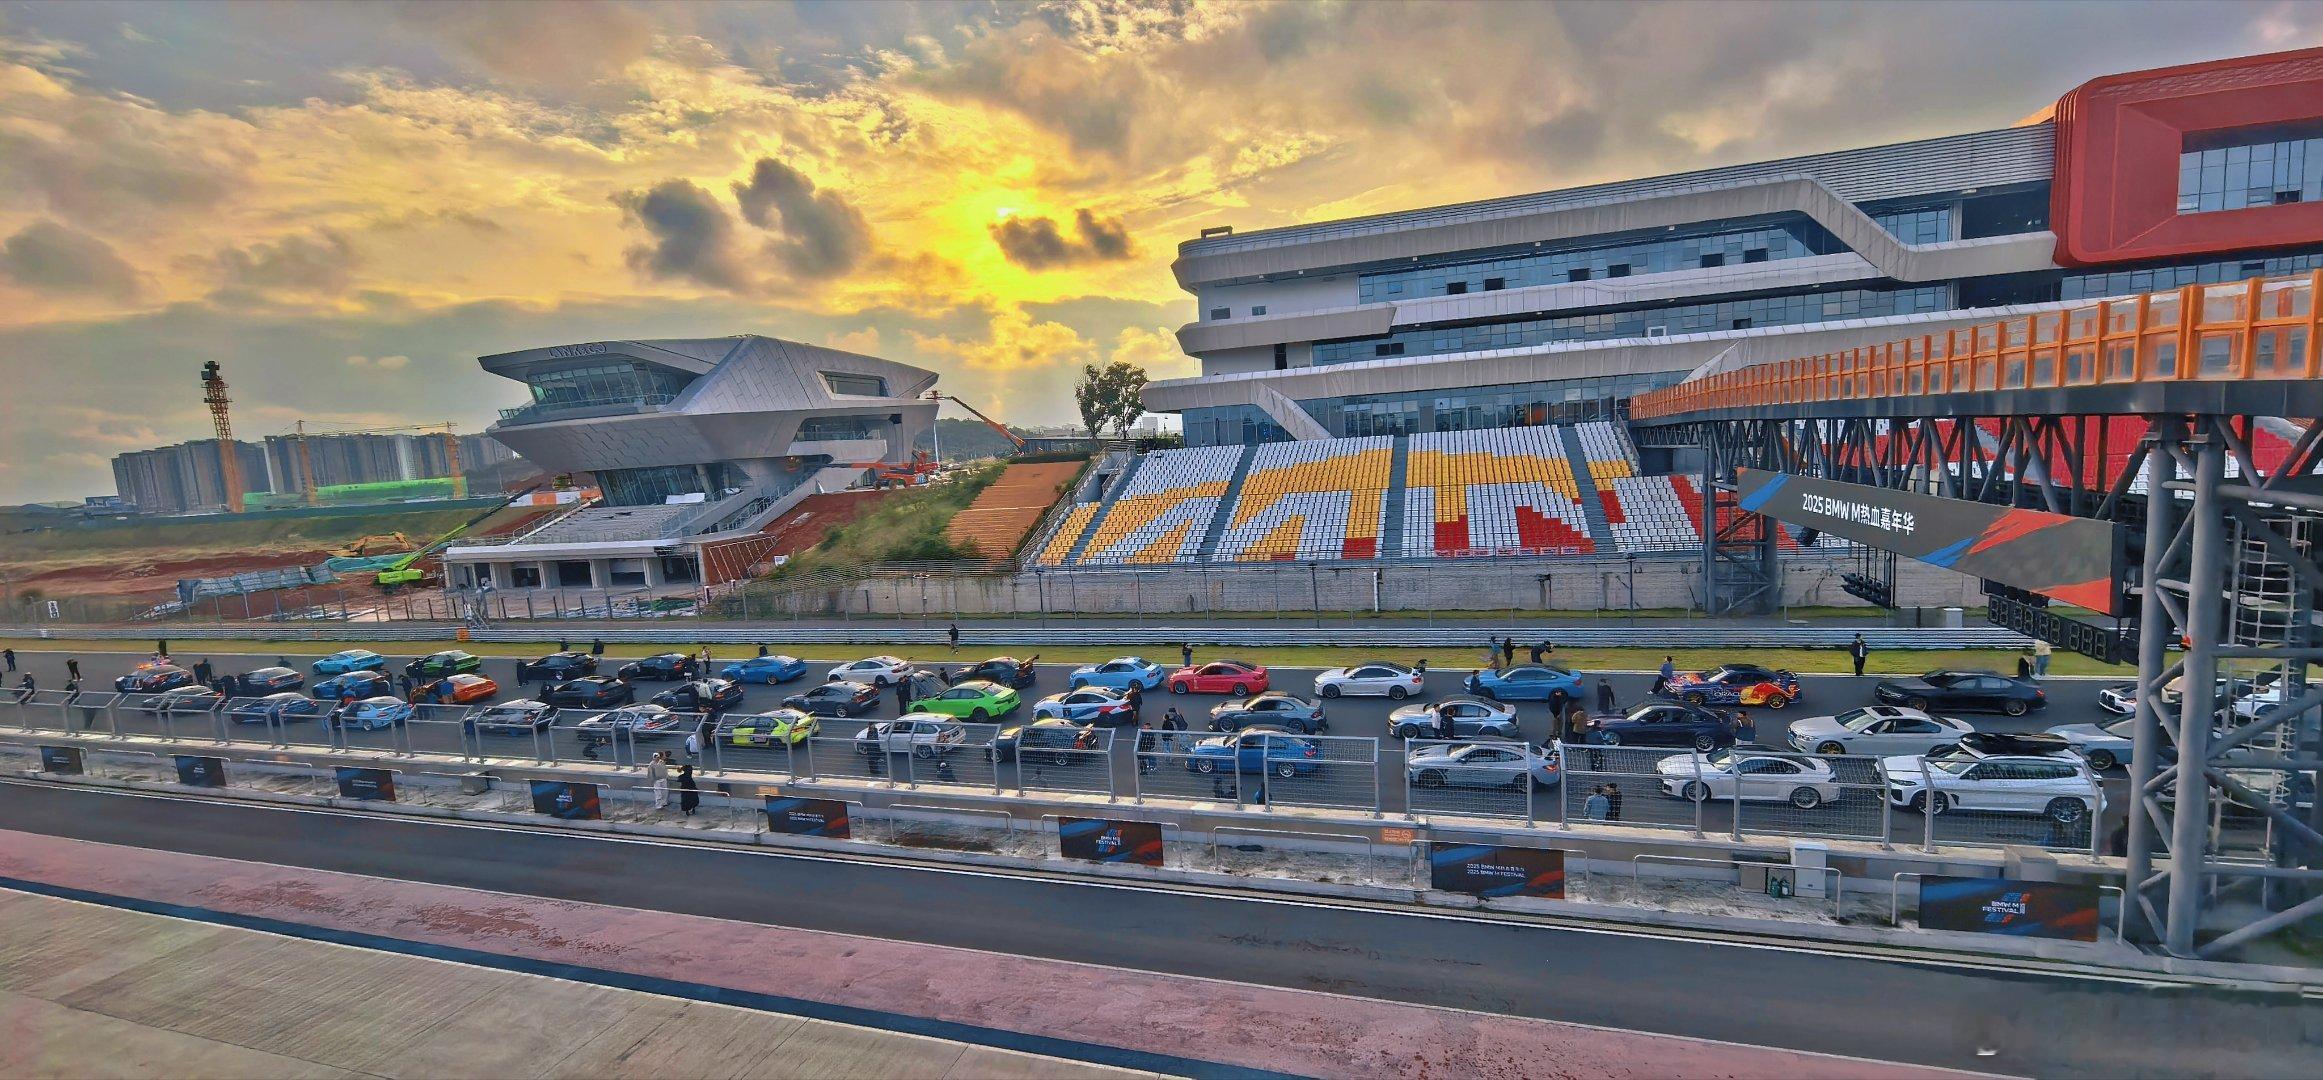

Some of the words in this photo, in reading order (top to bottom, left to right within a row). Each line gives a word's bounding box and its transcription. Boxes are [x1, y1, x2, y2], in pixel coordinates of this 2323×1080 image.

[1802, 493, 1824, 514] 2025
[1825, 497, 1850, 520] BMW
[1851, 502, 1915, 535] M热血嘉年华
[1982, 906, 2019, 914] FESTIVAL
